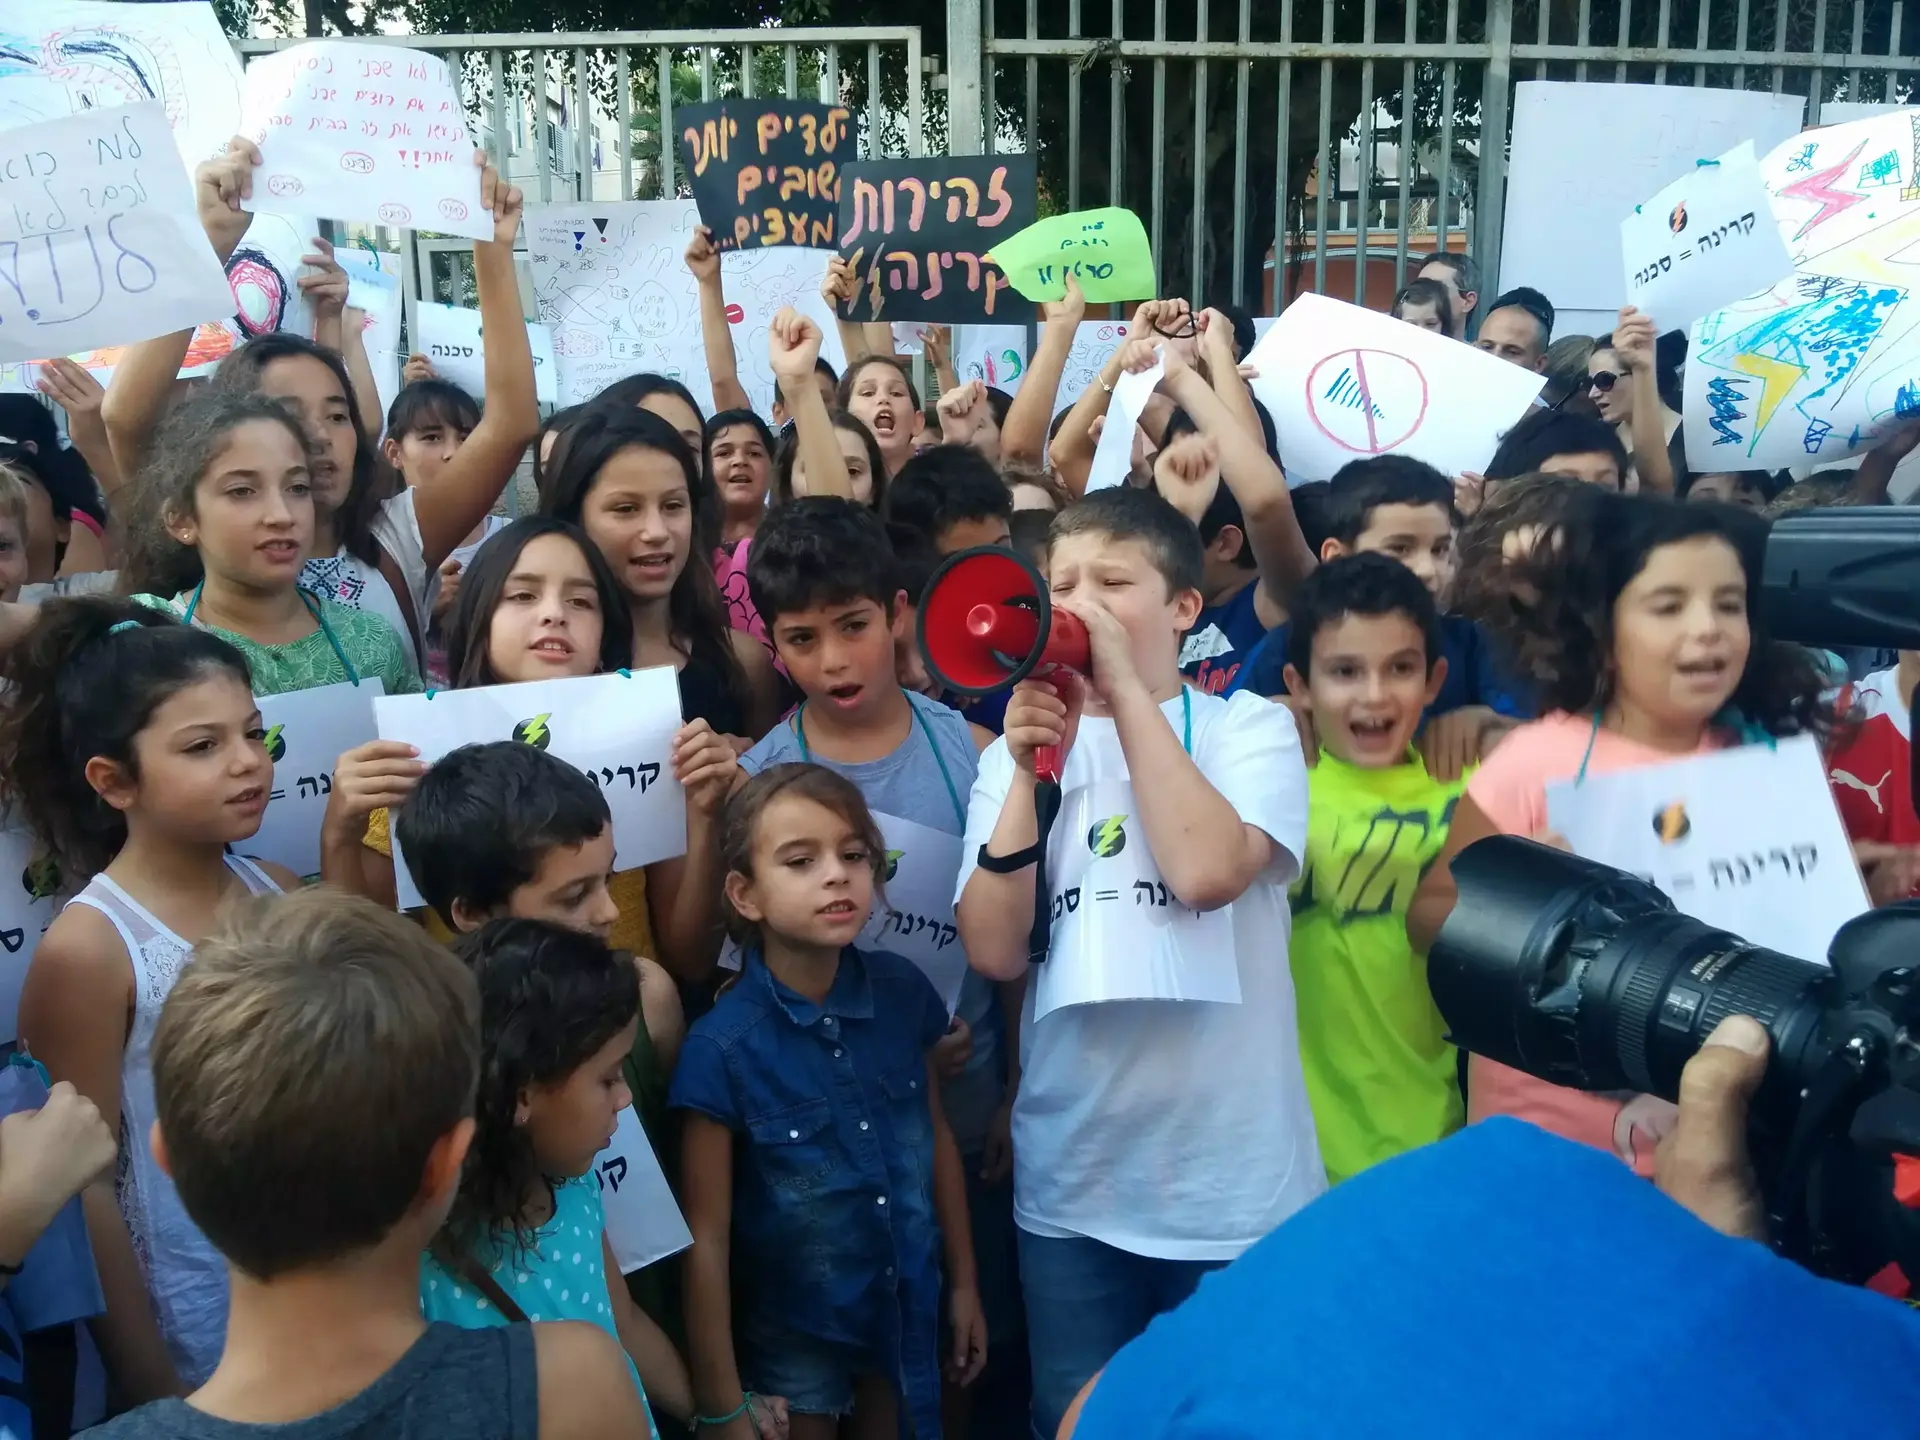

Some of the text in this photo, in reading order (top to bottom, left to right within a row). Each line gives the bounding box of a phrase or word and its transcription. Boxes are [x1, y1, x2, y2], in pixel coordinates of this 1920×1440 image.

[756, 107, 850, 156] ילדים
[840, 166, 1013, 248] זהירות
[1697, 211, 1756, 254] קרינה
[1634, 255, 1671, 290] סכנה
[431, 343, 474, 358] סכנה
